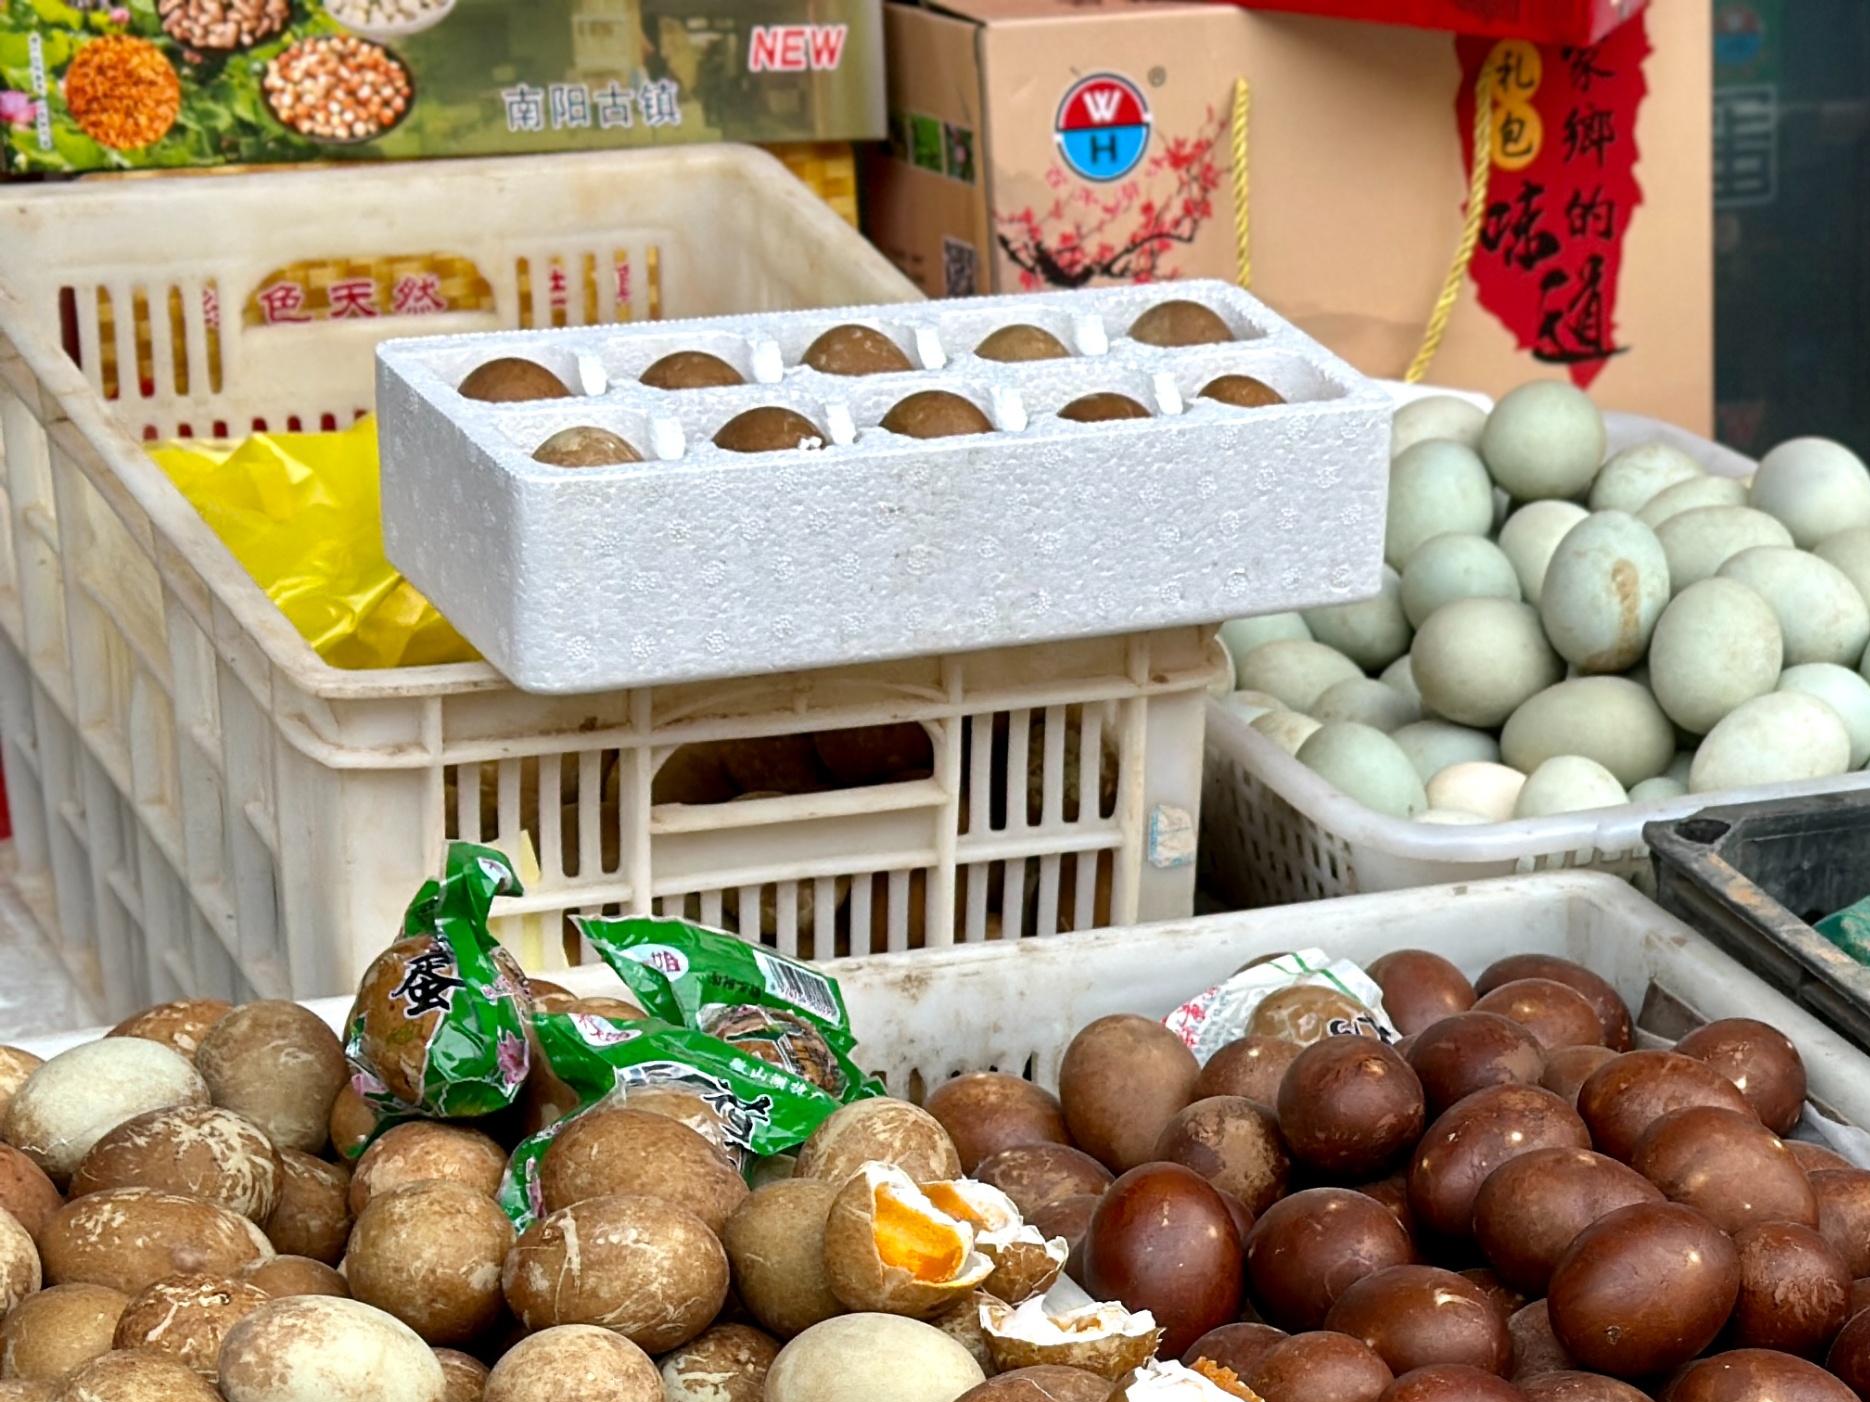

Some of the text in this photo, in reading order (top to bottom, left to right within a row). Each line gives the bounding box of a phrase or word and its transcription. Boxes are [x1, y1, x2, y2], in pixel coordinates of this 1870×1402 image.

[749, 24, 847, 72] NEW
[502, 79, 683, 132] 南阳古镇
[1082, 89, 1123, 123] W
[1495, 51, 1535, 158] 礼包
[1090, 132, 1118, 165] H
[389, 951, 469, 1019] 蛋
